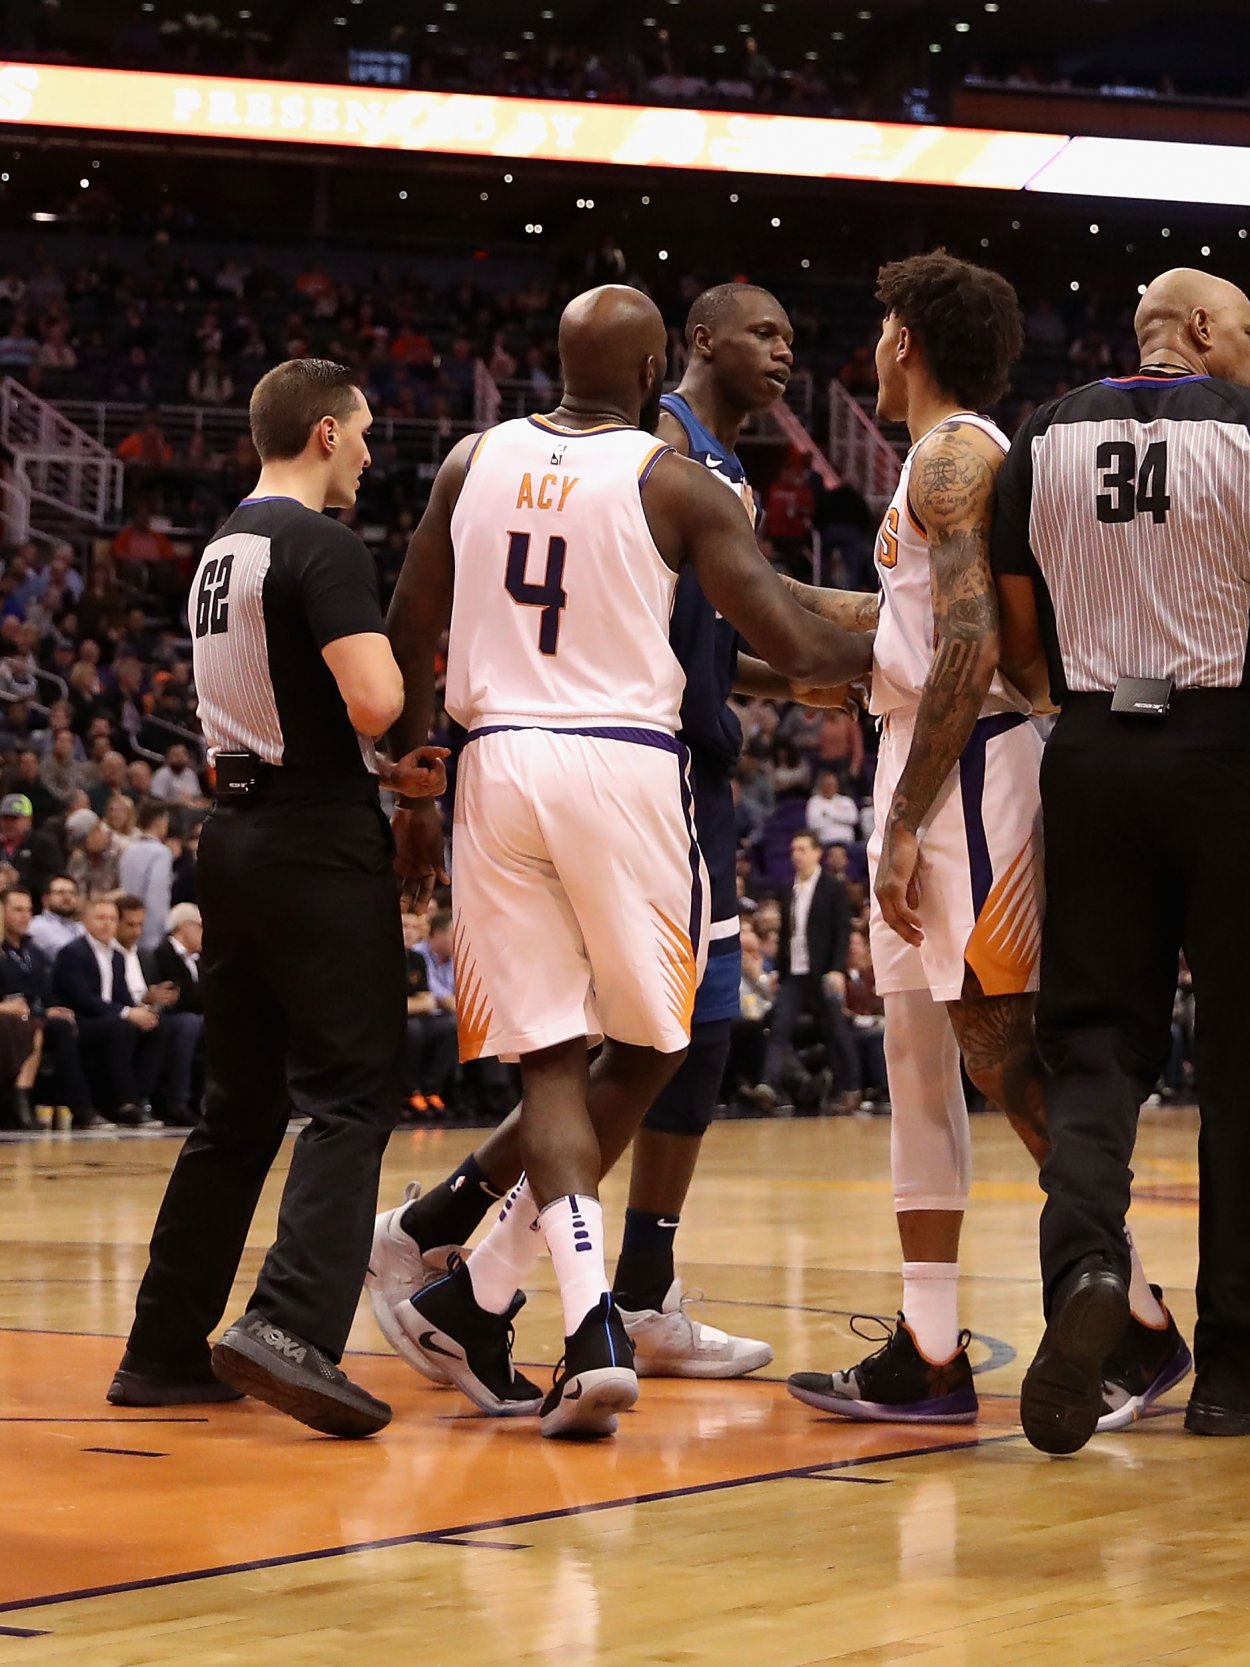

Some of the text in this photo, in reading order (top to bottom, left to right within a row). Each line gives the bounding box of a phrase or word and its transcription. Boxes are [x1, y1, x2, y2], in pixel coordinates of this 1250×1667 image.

[516, 473, 579, 511] ACY
[1096, 441, 1170, 524] 34
[196, 554, 234, 639] 62
[505, 531, 567, 657] 4
[248, 1321, 307, 1363] HOKA
